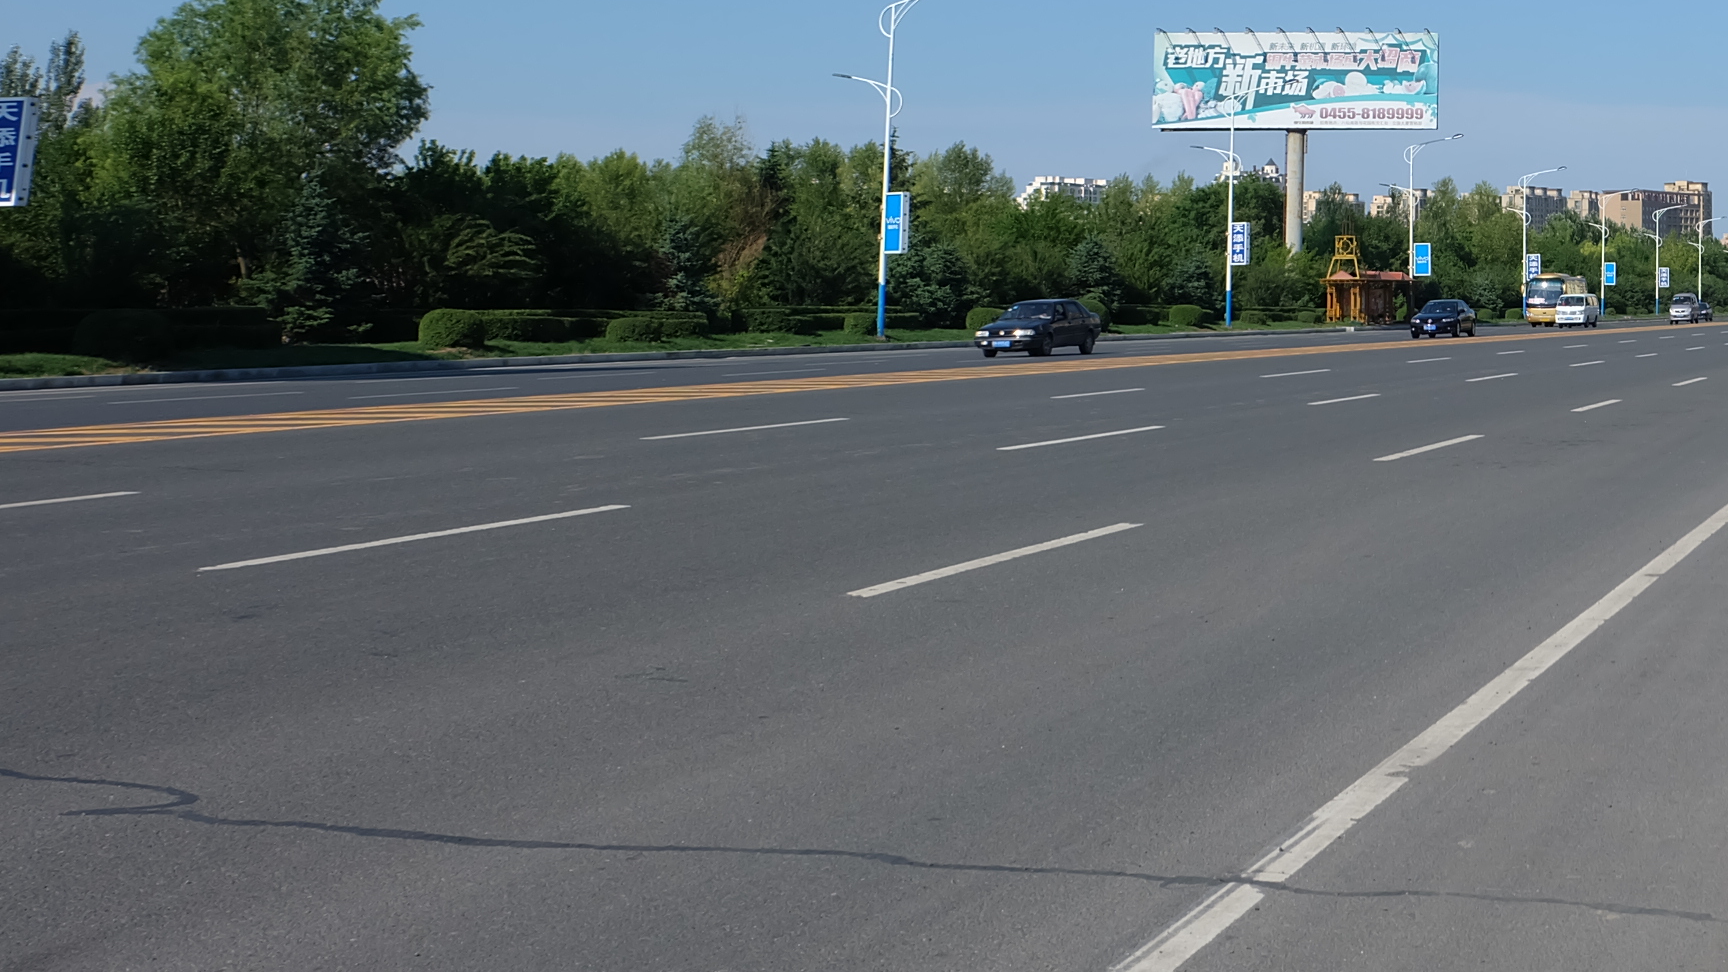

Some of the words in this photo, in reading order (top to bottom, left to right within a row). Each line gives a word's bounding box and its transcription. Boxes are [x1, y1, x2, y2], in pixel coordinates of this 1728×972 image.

[1167, 47, 1228, 68] 老地方
[1319, 107, 1424, 120] 0455-8189999
